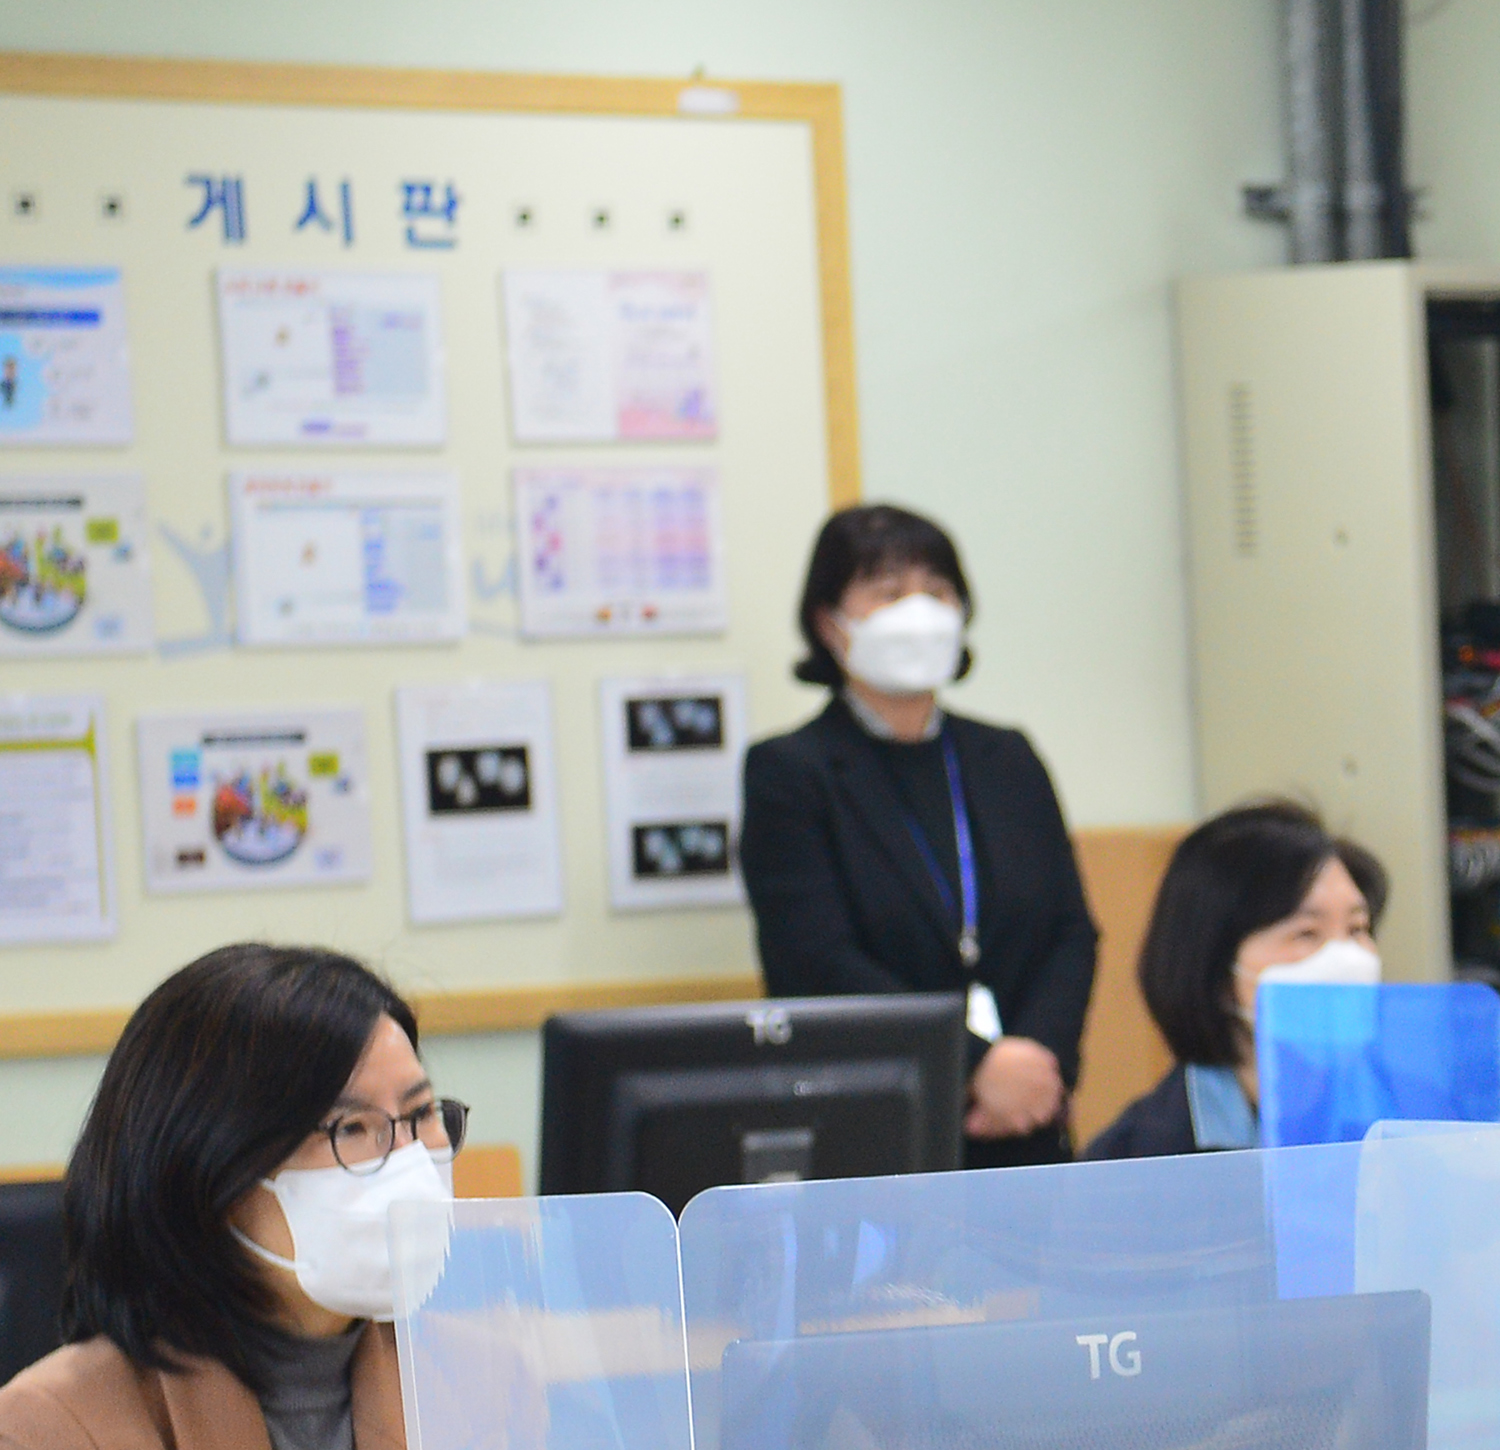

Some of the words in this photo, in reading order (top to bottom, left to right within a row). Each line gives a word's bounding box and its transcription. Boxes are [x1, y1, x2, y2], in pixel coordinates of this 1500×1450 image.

[185, 172, 457, 250] 게시판
[745, 1008, 792, 1046] TG
[1075, 1330, 1142, 1380] TG
